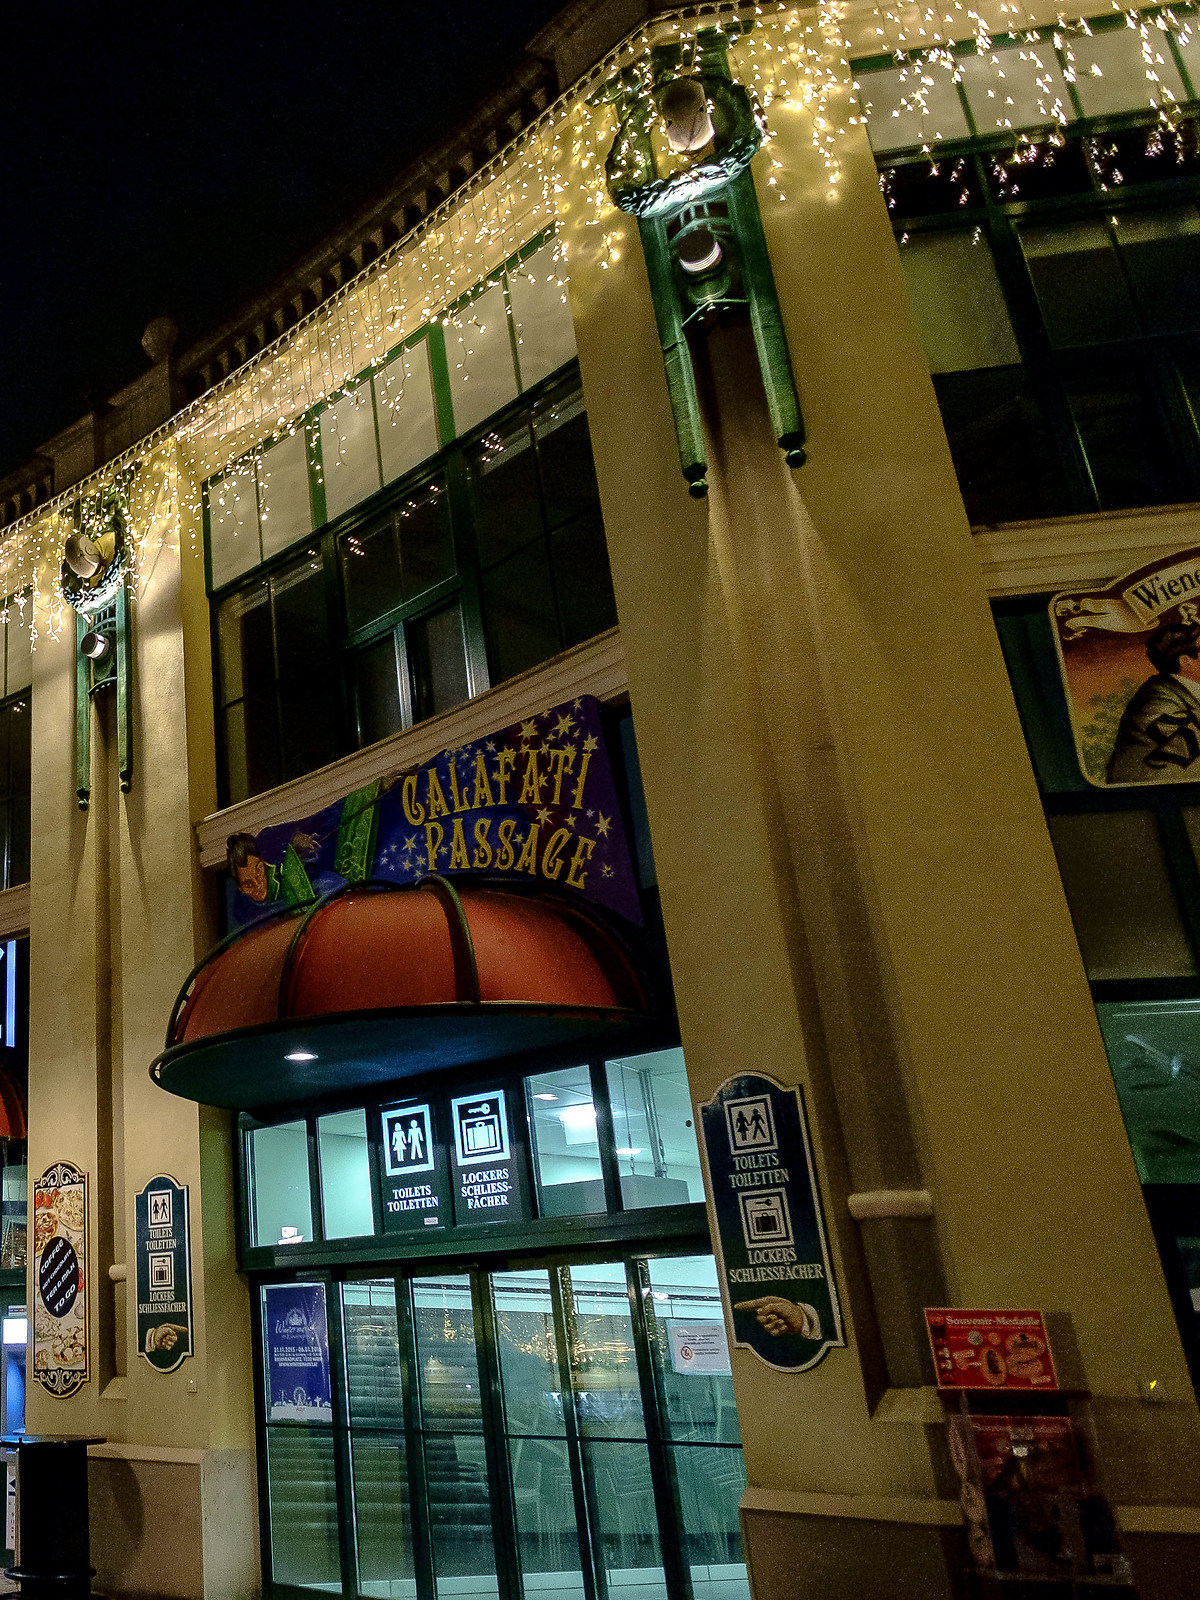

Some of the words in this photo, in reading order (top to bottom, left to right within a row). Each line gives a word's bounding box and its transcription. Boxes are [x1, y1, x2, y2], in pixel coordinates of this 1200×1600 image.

[402, 748, 592, 826] CALAFATI
[424, 818, 597, 890] PASSAGE
[733, 1152, 780, 1171] TOILETS
[462, 1168, 510, 1185] LOCKERS
[728, 1168, 790, 1188] TOILETTEN
[392, 1184, 432, 1200] TOILETS
[461, 1181, 513, 1197] SCHLIESS-
[387, 1196, 439, 1212] TOILETTEN
[467, 1194, 509, 1209] FÄCHER
[149, 1228, 173, 1239] TOILETS
[145, 1239, 177, 1251] TOILETTEN
[40, 1239, 64, 1274] COFFEE
[748, 1247, 798, 1265] LOCKERS
[729, 1262, 825, 1283] SCHLIESSFÄCHER
[54, 1297, 65, 1312] TO
[65, 1283, 76, 1299] GO
[149, 1291, 175, 1302] LOCKERS
[138, 1302, 187, 1313] SCHLIESSFÄCHER
